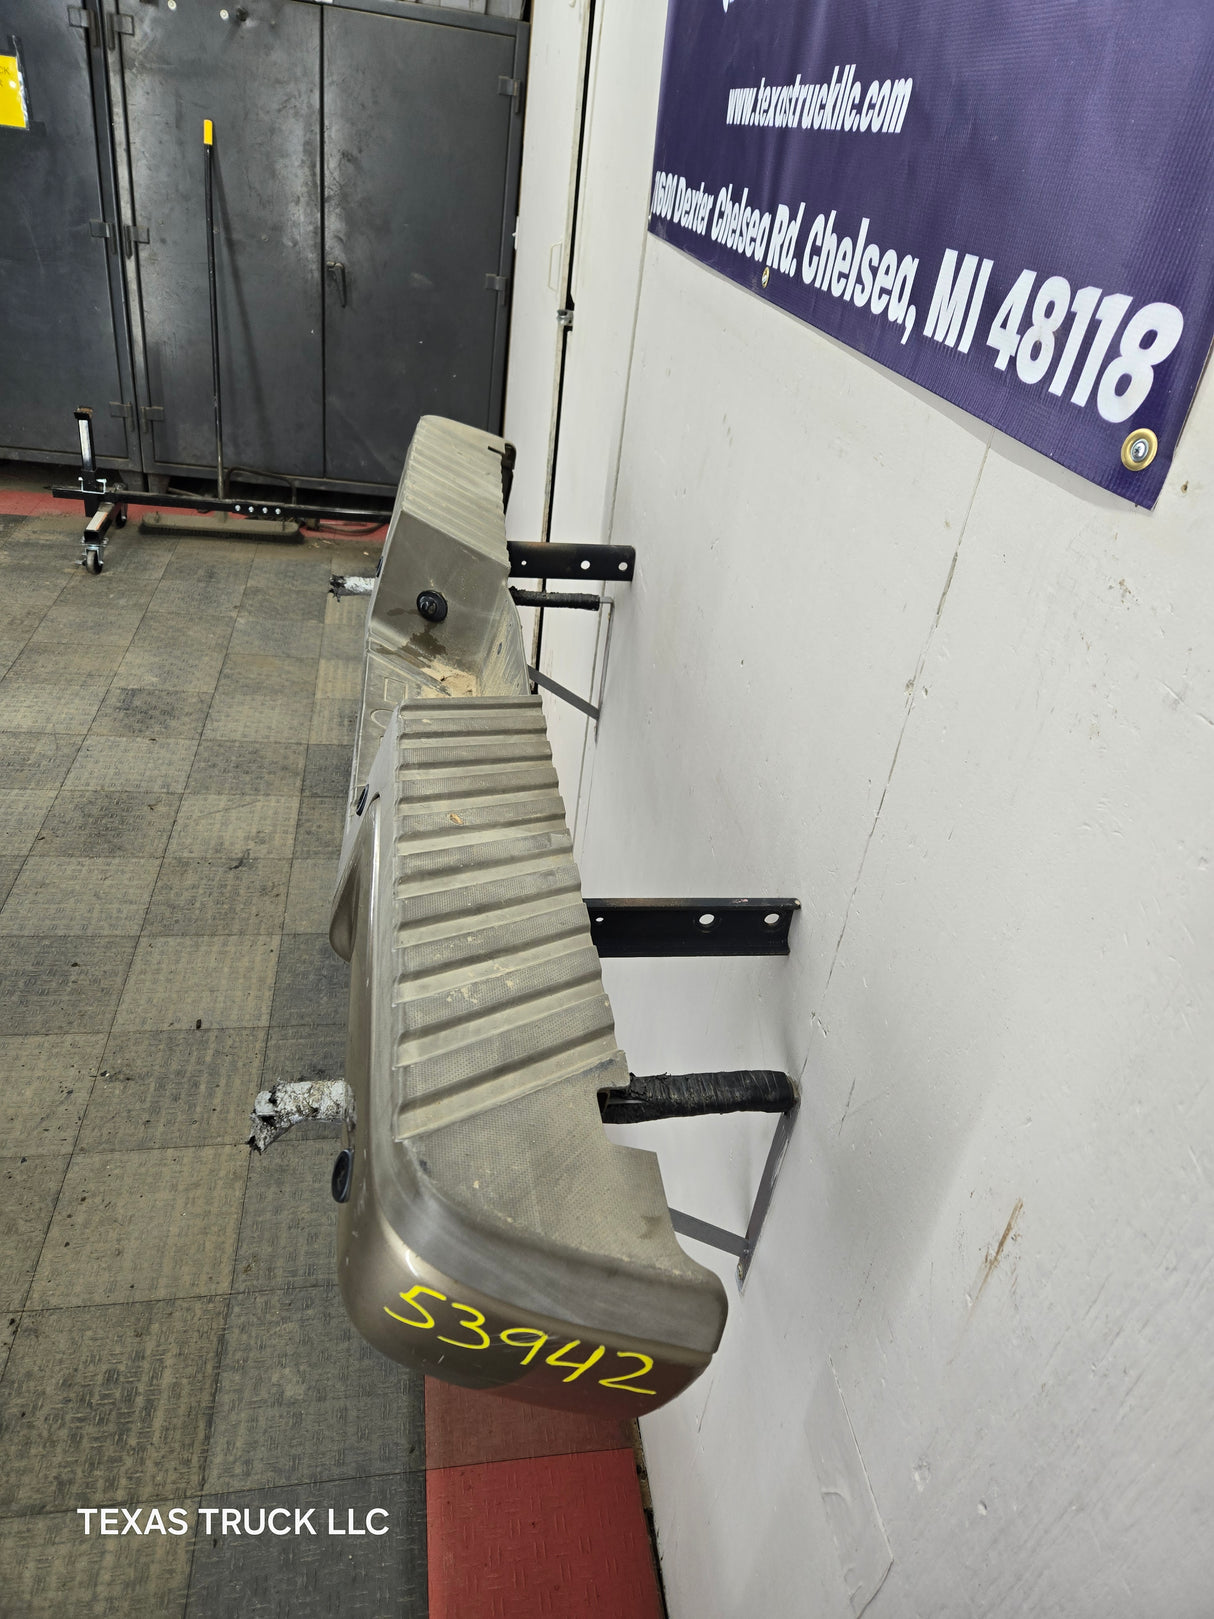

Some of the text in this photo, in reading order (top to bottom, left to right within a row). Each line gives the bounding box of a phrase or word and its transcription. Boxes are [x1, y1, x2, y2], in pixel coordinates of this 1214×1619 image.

[726, 64, 913, 134] www.texastruckllc.com
[673, 176, 715, 236] Dexter
[710, 183, 772, 263] Chelsea
[766, 201, 806, 278] Rd.
[801, 209, 920, 345] Chelsea,
[922, 248, 995, 354] MI
[986, 268, 1184, 424] 48118
[383, 1285, 657, 1395] 53942
